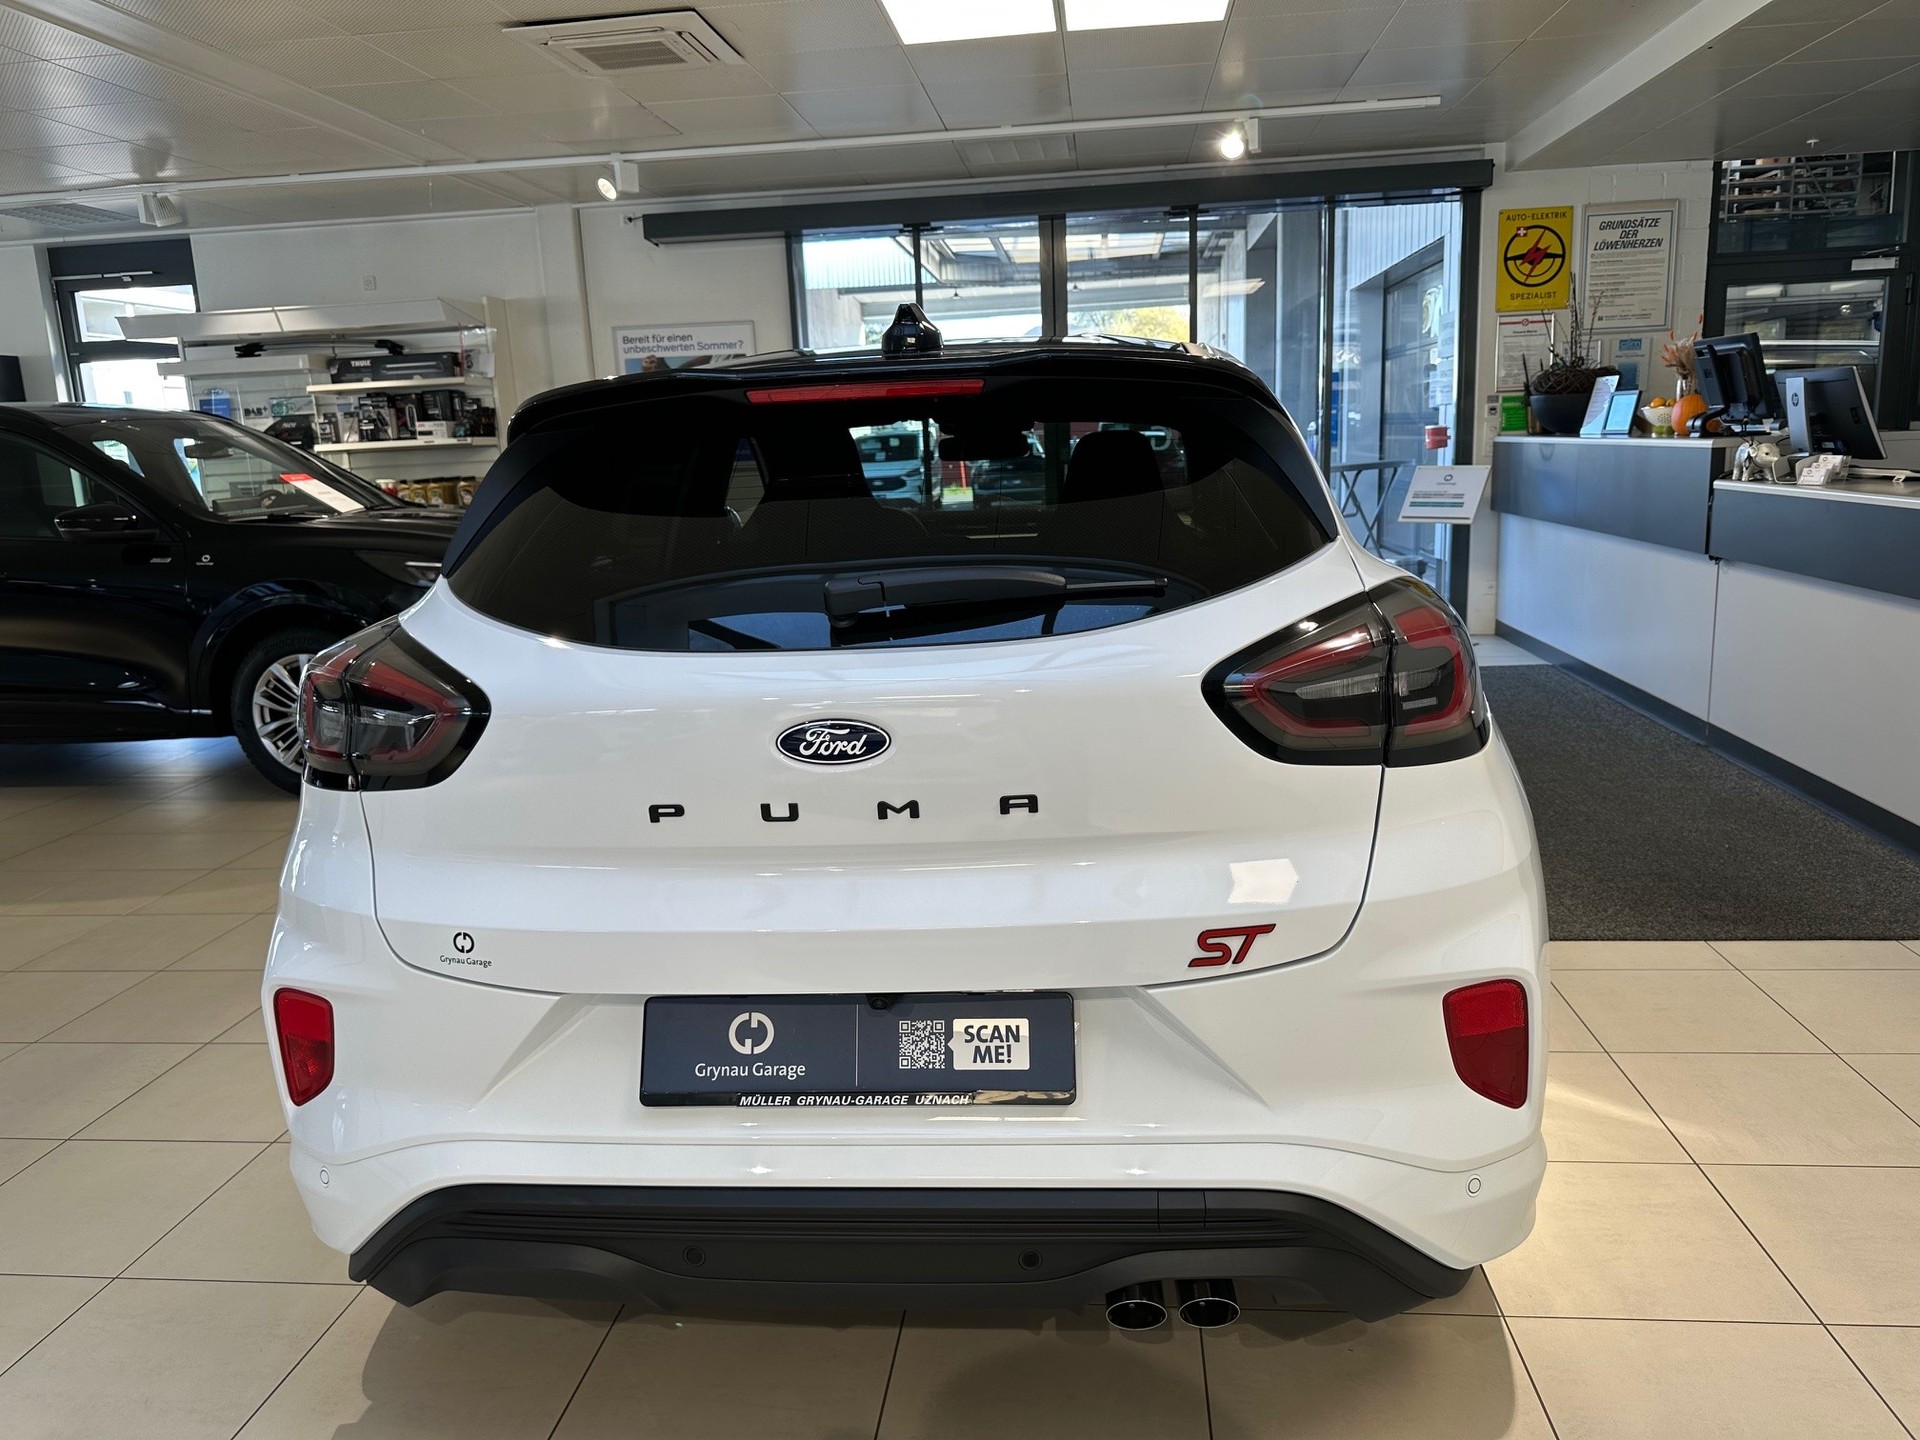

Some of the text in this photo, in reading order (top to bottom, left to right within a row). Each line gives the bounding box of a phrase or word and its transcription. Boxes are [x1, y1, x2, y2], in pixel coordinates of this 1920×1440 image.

[1505, 211, 1568, 221] AUTO-ELEKTRIK
[1598, 217, 1661, 231] GRUNDSÄTZE
[1619, 229, 1639, 240] DER
[1593, 238, 1664, 251] LÖWENHERZEN
[1510, 291, 1557, 301] SPEZIALIST
[622, 334, 693, 345] Bereit für einen
[623, 340, 744, 354] unbeschwerten Sommer?
[350, 359, 372, 368] THULE
[799, 728, 866, 756] Ford
[648, 793, 1039, 824] PUMA
[1187, 923, 1277, 968] ST
[439, 954, 492, 968] Grynau Garage
[963, 1024, 1021, 1044] SCAN
[972, 1044, 1013, 1064] ME!
[694, 1062, 806, 1081] Grynau Garage
[739, 1093, 970, 1107] MÜLLER GRYNAU-GARAGE UZNACH
